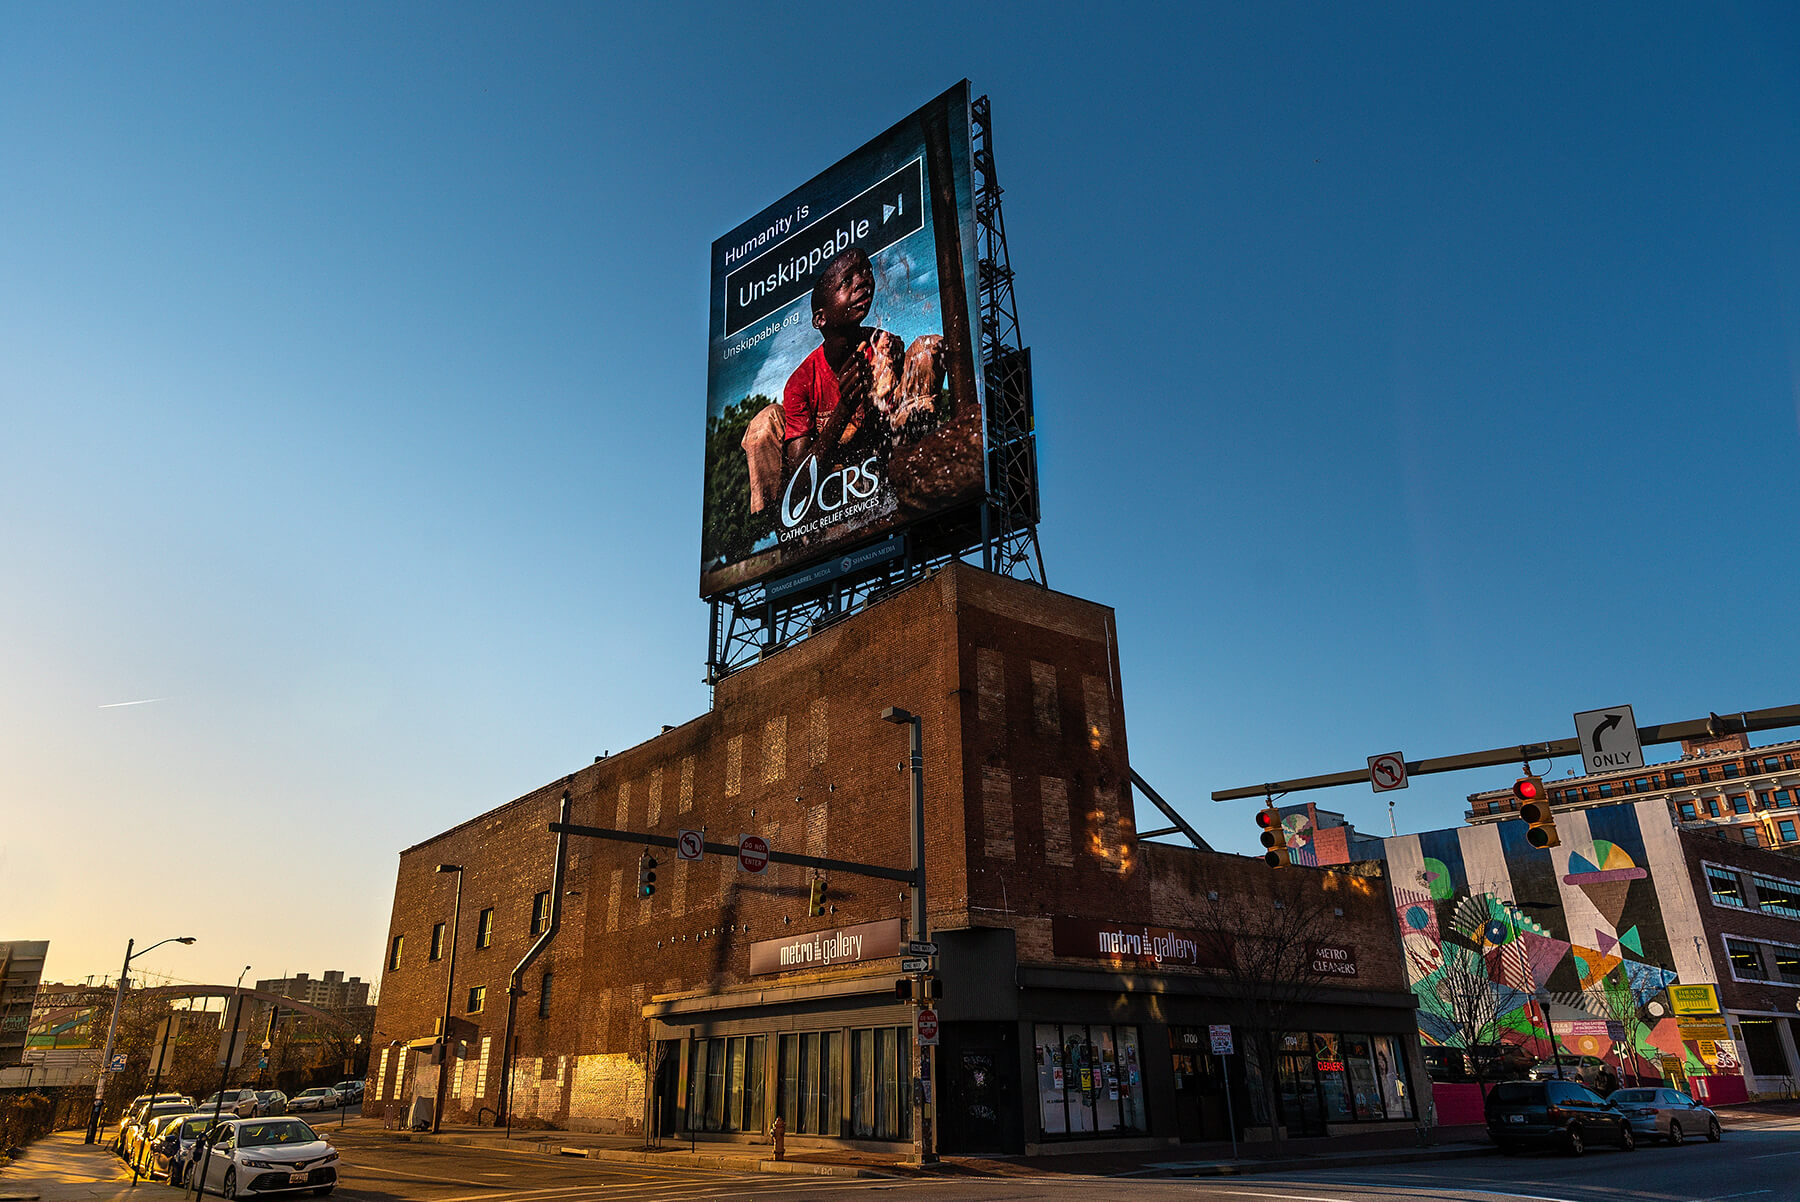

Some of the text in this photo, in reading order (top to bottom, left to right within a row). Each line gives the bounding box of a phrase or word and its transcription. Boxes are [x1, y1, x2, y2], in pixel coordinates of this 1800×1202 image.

[725, 205, 809, 267] Humanity is
[739, 219, 870, 307] Unskippable
[723, 311, 800, 361] Unskippable.org
[817, 456, 879, 511] CRS
[780, 496, 880, 542] CATHOLIC RELIEF SERVICES
[1593, 751, 1631, 768] ONLY
[744, 841, 766, 852] DO NOT
[744, 858, 762, 867] ENTER
[780, 931, 863, 966] metro gallery
[1099, 930, 1197, 964] metro gallery
[1315, 948, 1348, 960] METRO
[1312, 960, 1356, 975] CLEANERS
[1183, 1034, 1198, 1044] 1700
[1317, 1060, 1344, 1072] CLEANERS
